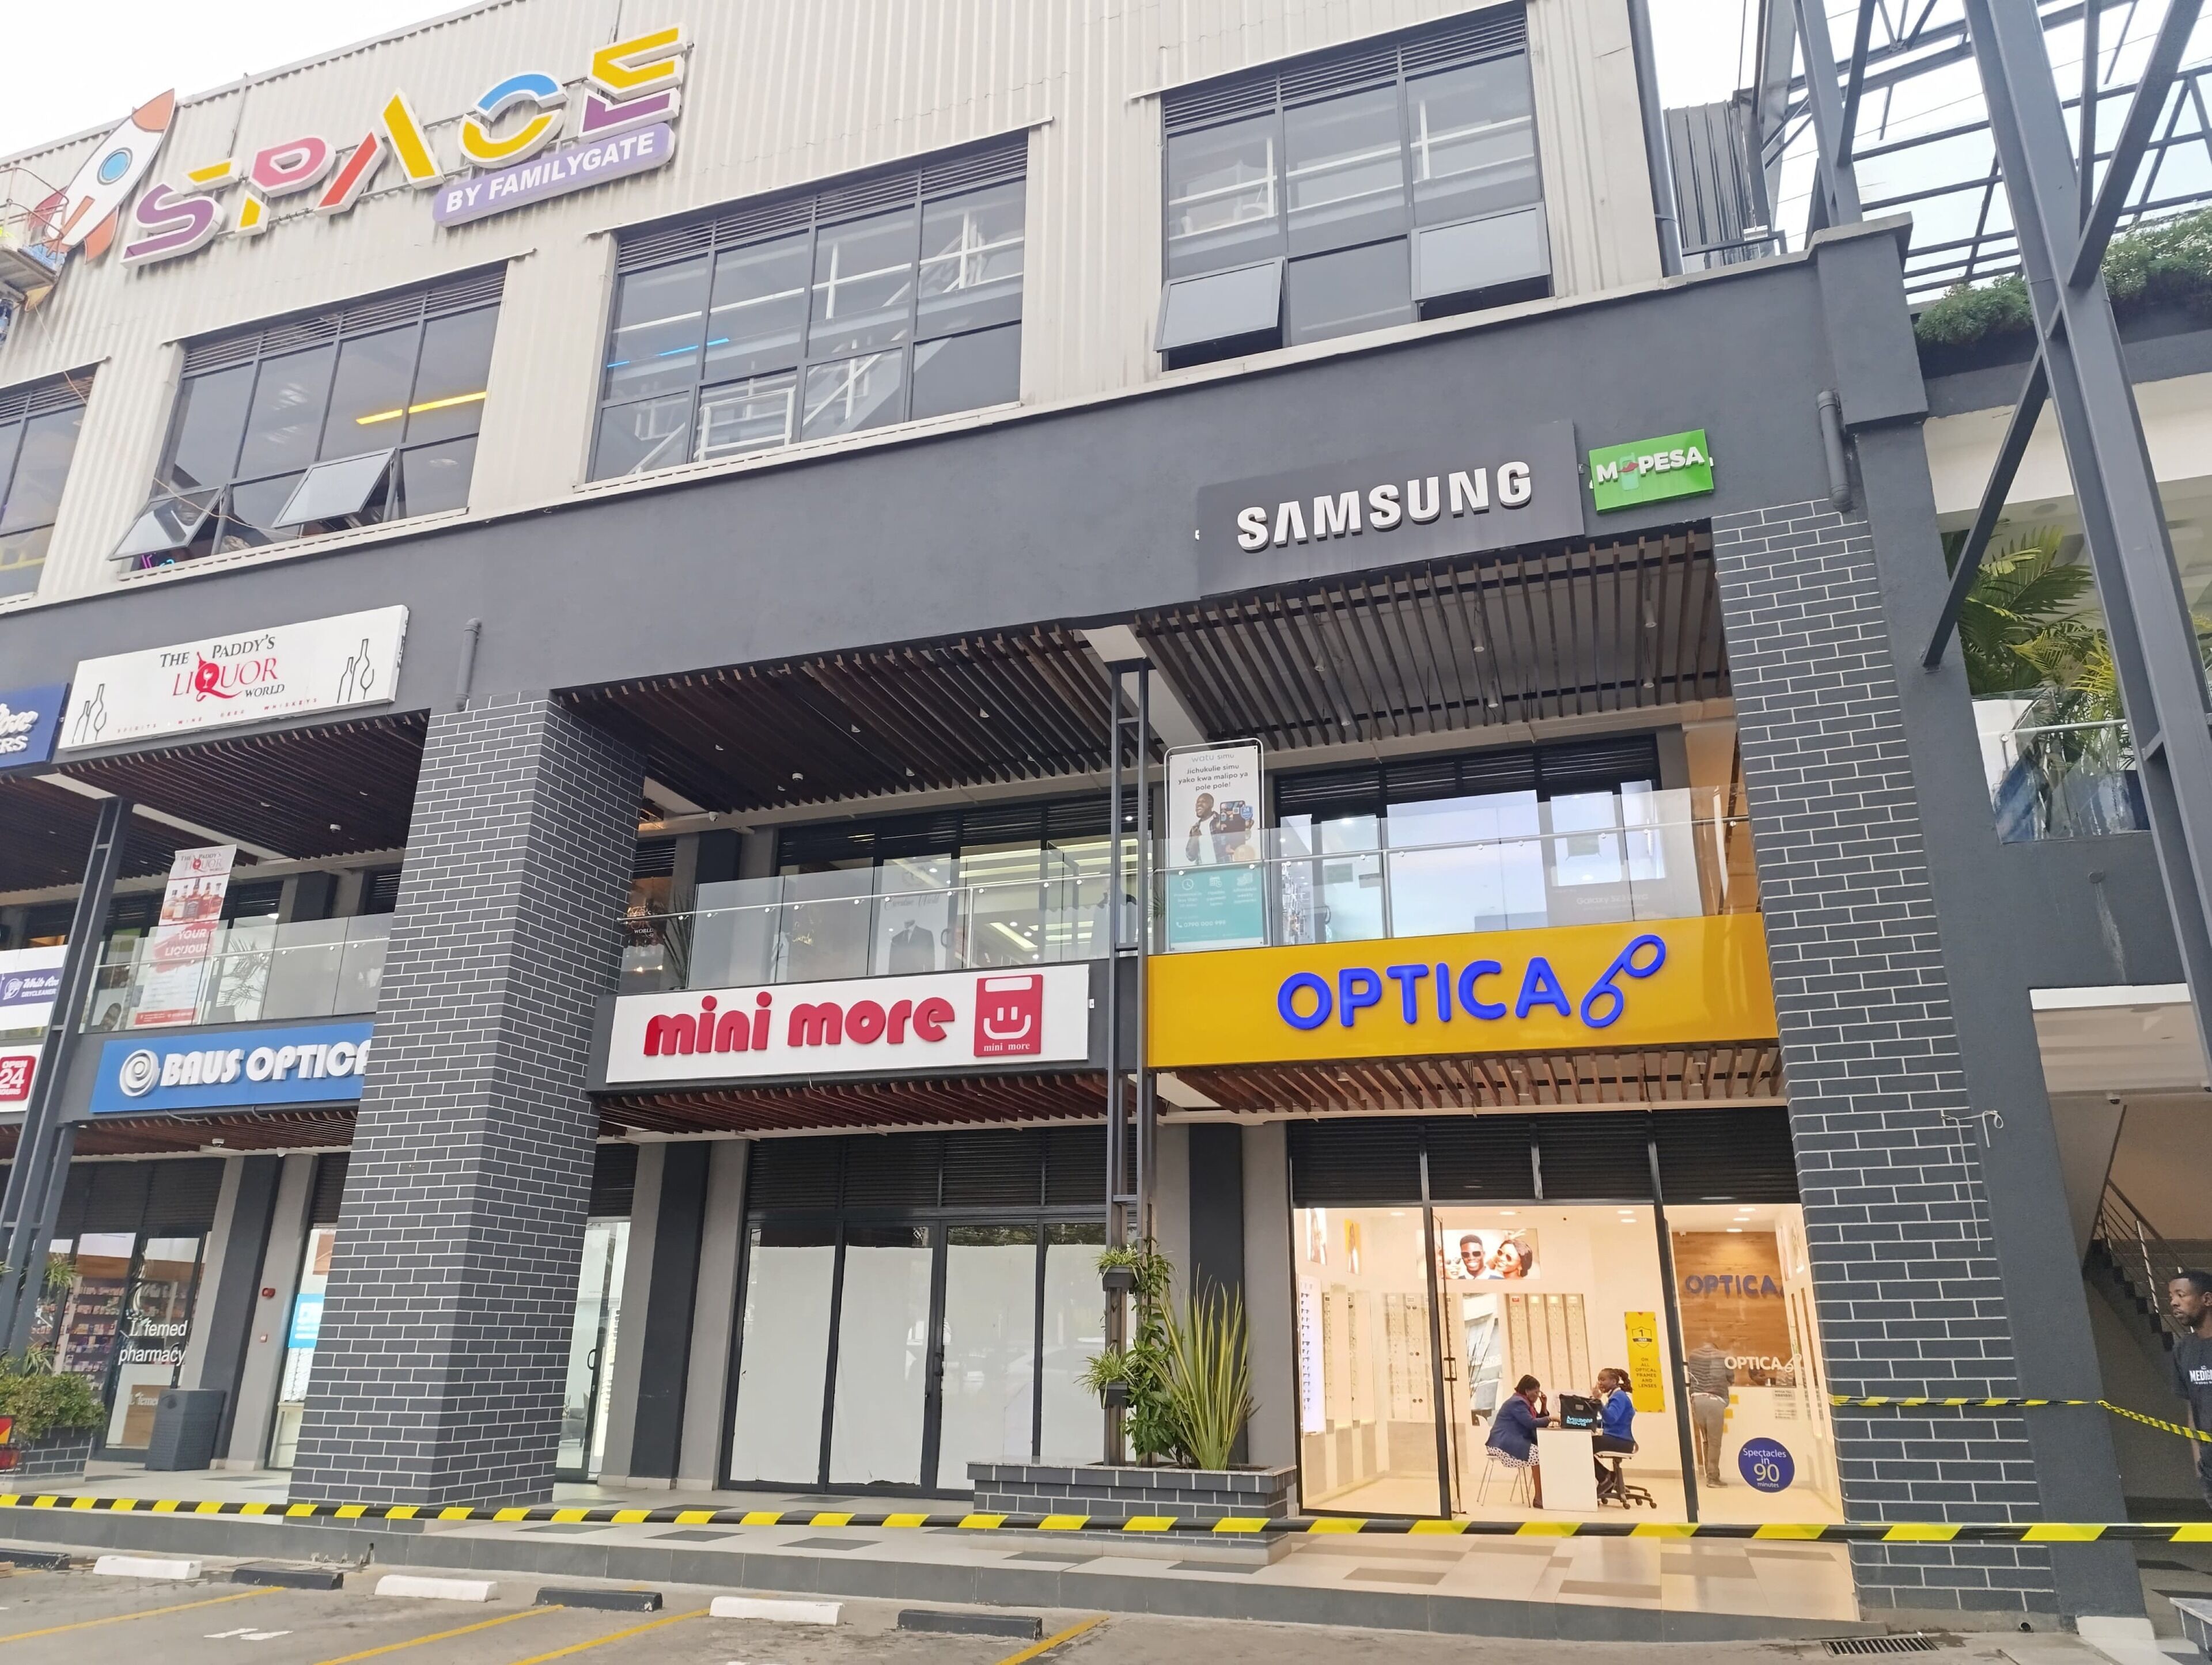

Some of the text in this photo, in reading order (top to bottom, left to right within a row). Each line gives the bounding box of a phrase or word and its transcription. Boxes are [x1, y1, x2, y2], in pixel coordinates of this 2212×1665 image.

[120, 24, 685, 269] SPACE
[445, 132, 654, 213] BY FAMILYGATE
[1237, 461, 1531, 551] SAMSUNG
[160, 635, 275, 667] THE PADDY'S
[173, 651, 278, 702] LIQUOR
[245, 684, 285, 697] WORLD
[264, 697, 317, 711] WHISKEYS
[1187, 765, 1221, 774] Jichukulie
[1576, 897, 1609, 905] Galaxy
[179, 929, 207, 940] YOUR
[1278, 957, 1571, 1030] OPTICA
[643, 991, 955, 1057] mini more
[983, 1043, 1003, 1052] mini
[2, 1060, 28, 1069] OPEN
[160, 1048, 245, 1086] BAUS
[0, 1068, 25, 1088] 24
[1685, 1275, 1781, 1299] OPTICA
[118, 1345, 186, 1367] pharmacy
[1725, 1356, 1783, 1370] OPTICA
[1743, 1448, 1787, 1458] Spectacles
[1762, 1456, 1770, 1465] in
[1753, 1463, 1780, 1482] 90
